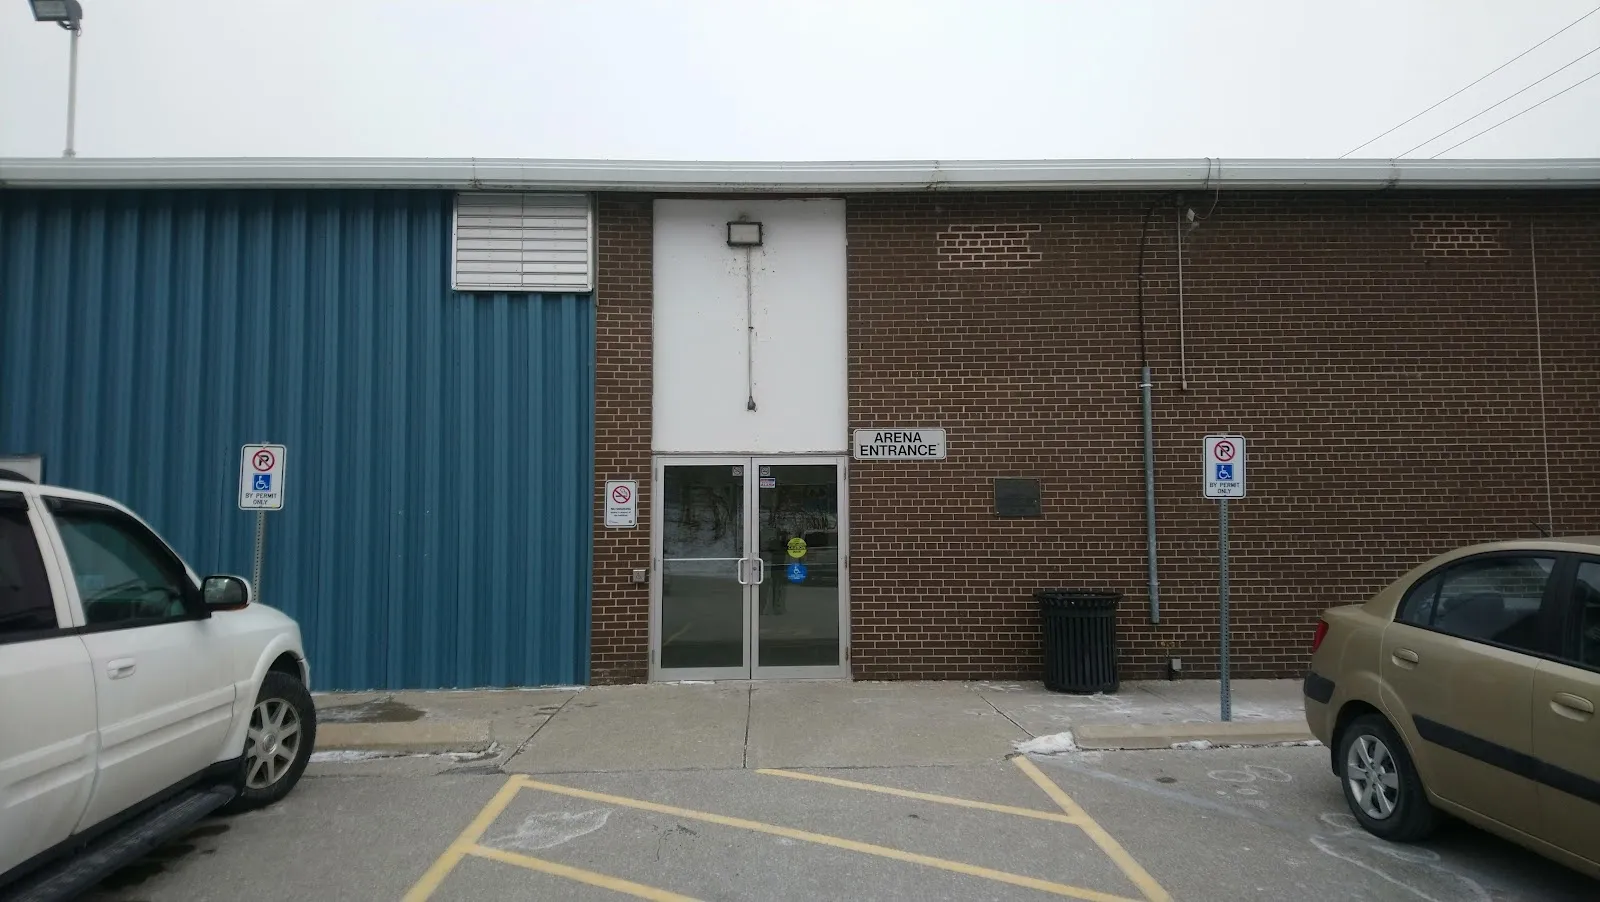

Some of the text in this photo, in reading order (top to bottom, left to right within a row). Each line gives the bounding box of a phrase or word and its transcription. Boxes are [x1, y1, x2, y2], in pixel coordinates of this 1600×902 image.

[874, 432, 922, 443] ARENA
[860, 444, 937, 456] ENTRANCE
[1220, 445, 1230, 456] P
[258, 454, 270, 466] P
